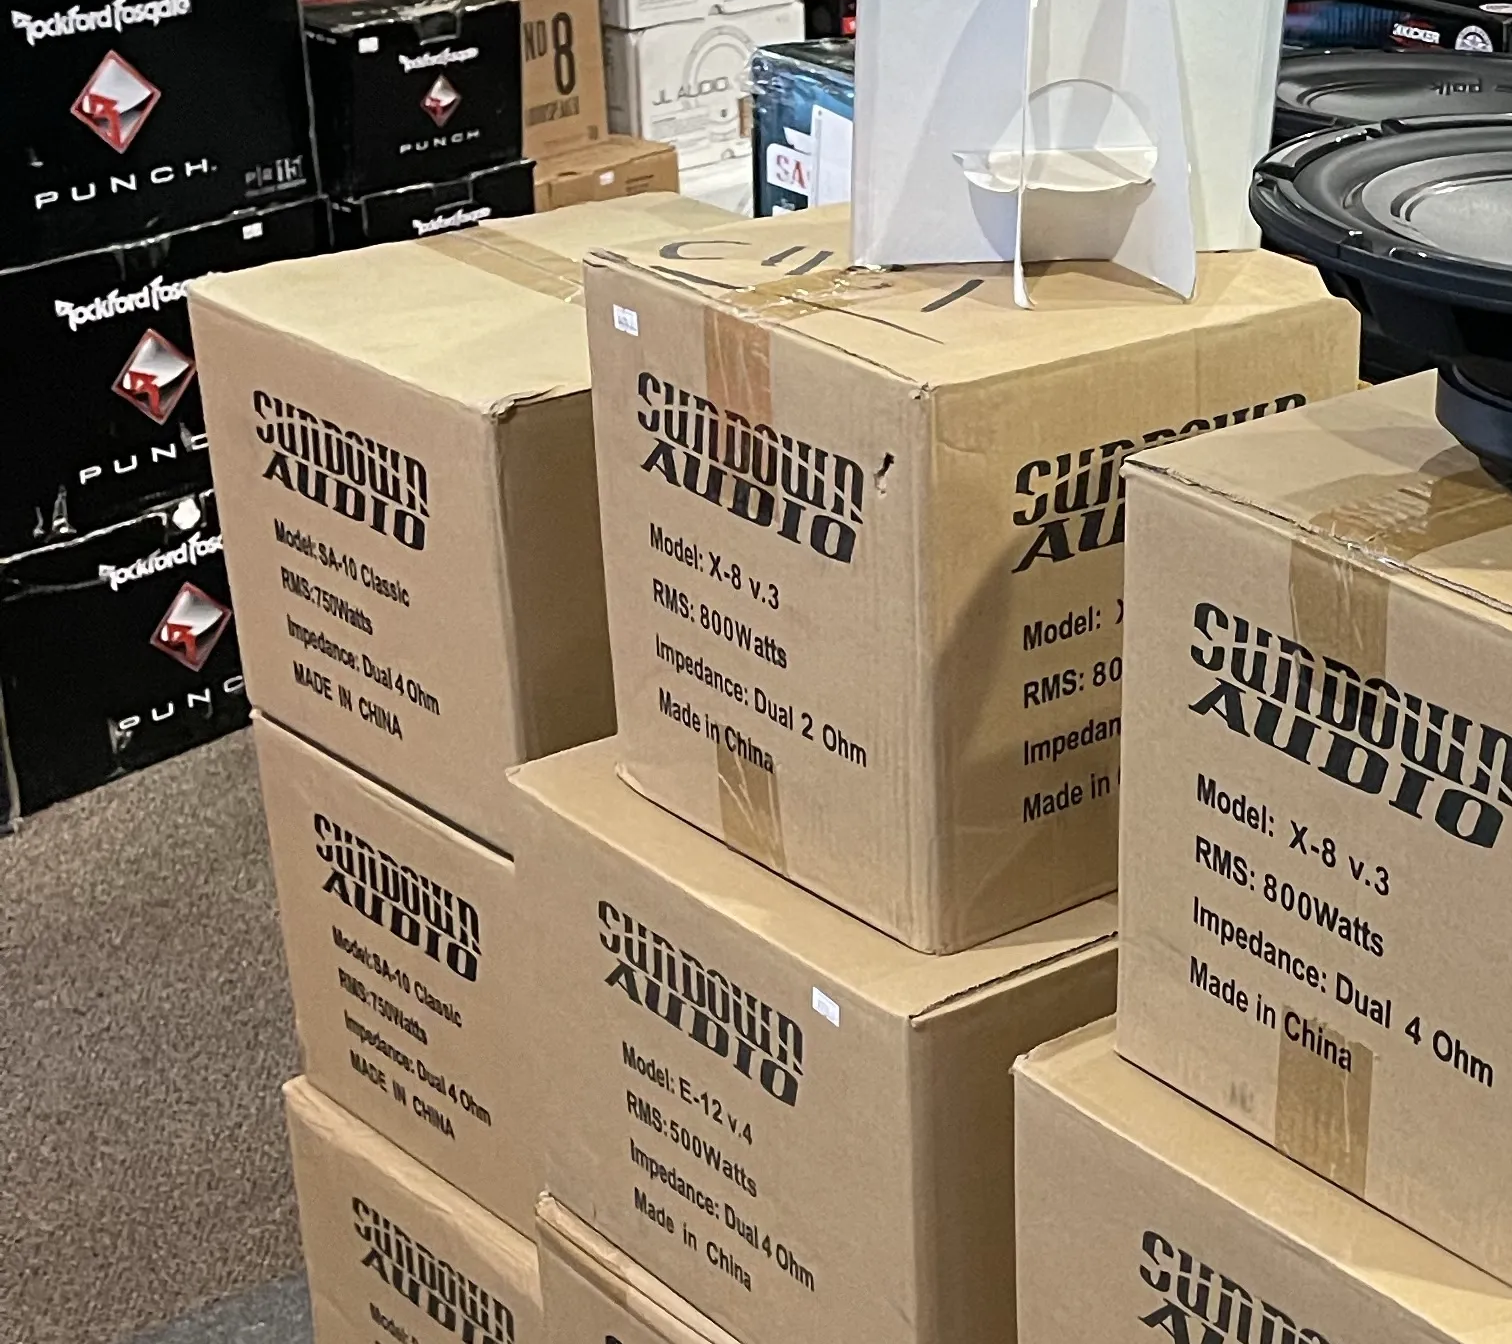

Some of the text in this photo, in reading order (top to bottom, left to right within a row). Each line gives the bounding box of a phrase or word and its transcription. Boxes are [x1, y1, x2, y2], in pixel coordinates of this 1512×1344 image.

[553, 12, 575, 95] 8
[400, 129, 481, 154] PUNCH
[253, 390, 429, 517] SUNDOWN
[262, 451, 425, 550] AUDIO
[637, 372, 863, 524] SUNDOWN
[641, 438, 856, 563] AUDIO
[275, 519, 316, 557] Model:
[361, 565, 410, 606] Classic
[650, 523, 779, 609] Model: X-8 v.3
[653, 578, 787, 669] RMS: 800Watts
[656, 633, 867, 767] Impedance: Dual 2 Ohm
[659, 687, 774, 774] Made in China
[1188, 677, 1504, 848] AUDIO
[314, 813, 482, 955] SUNDOWN
[1196, 835, 1384, 958] RMS: 800Watts
[1197, 773, 1390, 897] Model: X-8 v.3
[322, 868, 476, 982] AUDIO
[599, 900, 803, 1075] SUNDOWN
[604, 958, 798, 1107] AUDIO
[1190, 956, 1353, 1073] Made in China
[1194, 897, 1494, 1089] Impedance: Dual 4 Ohm
